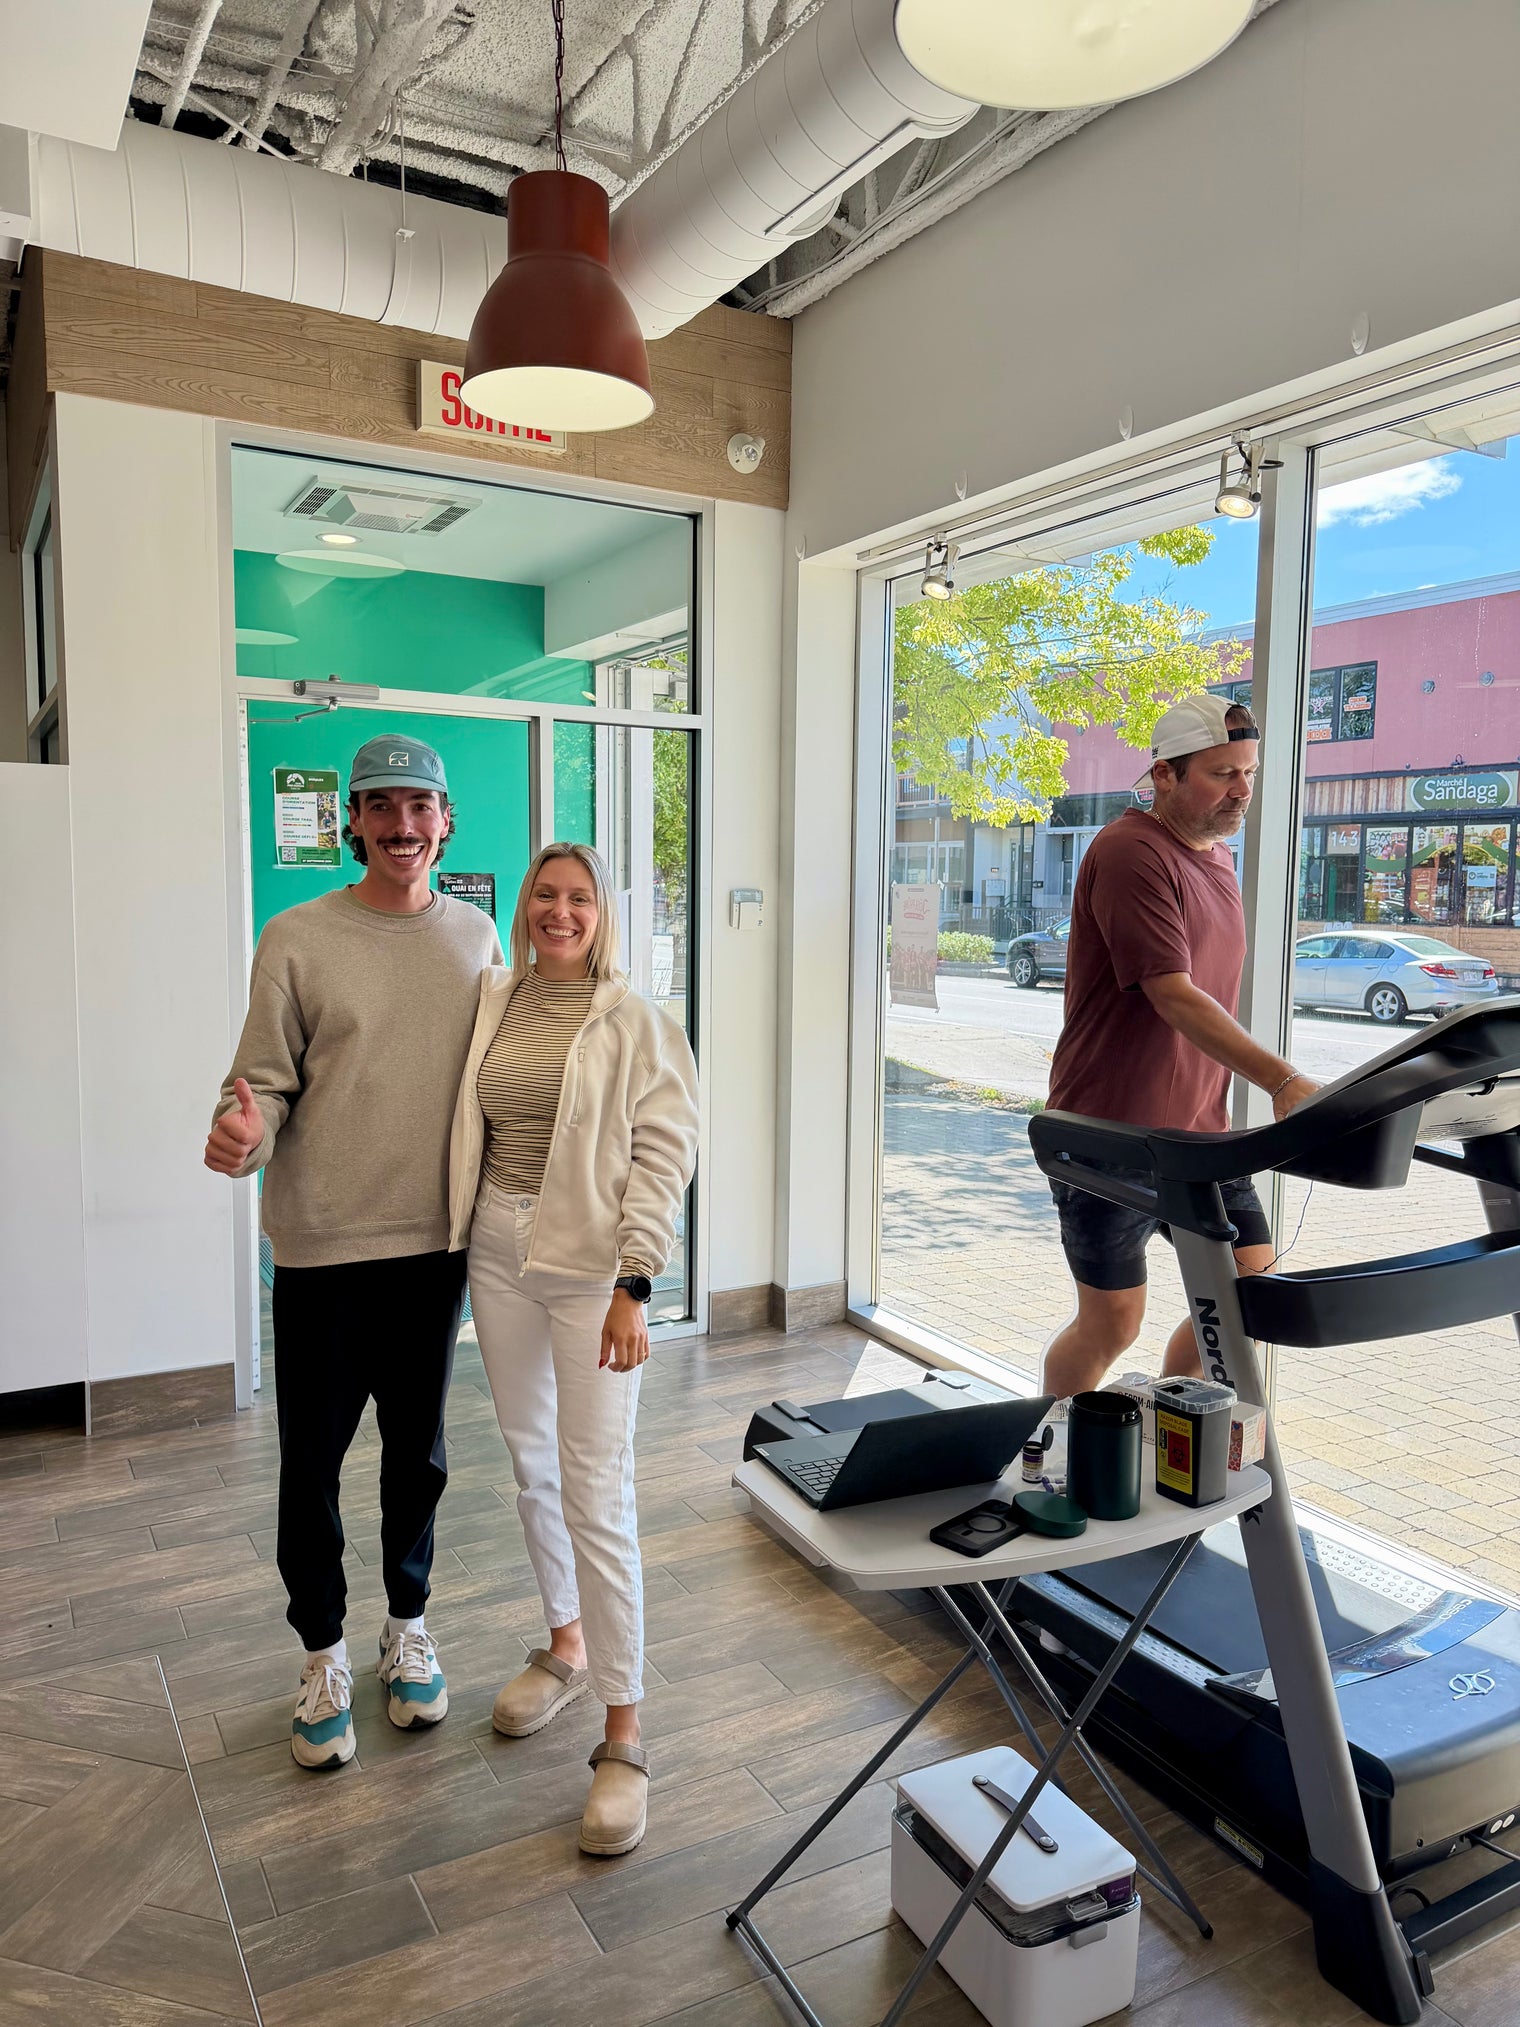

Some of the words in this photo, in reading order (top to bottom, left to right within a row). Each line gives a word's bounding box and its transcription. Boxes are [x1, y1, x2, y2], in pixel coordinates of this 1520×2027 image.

[1436, 779, 1463, 787] Marché
[1423, 778, 1498, 804] Sandaga
[1332, 831, 1358, 847] 143
[477, 884, 492, 892] FÊTE
